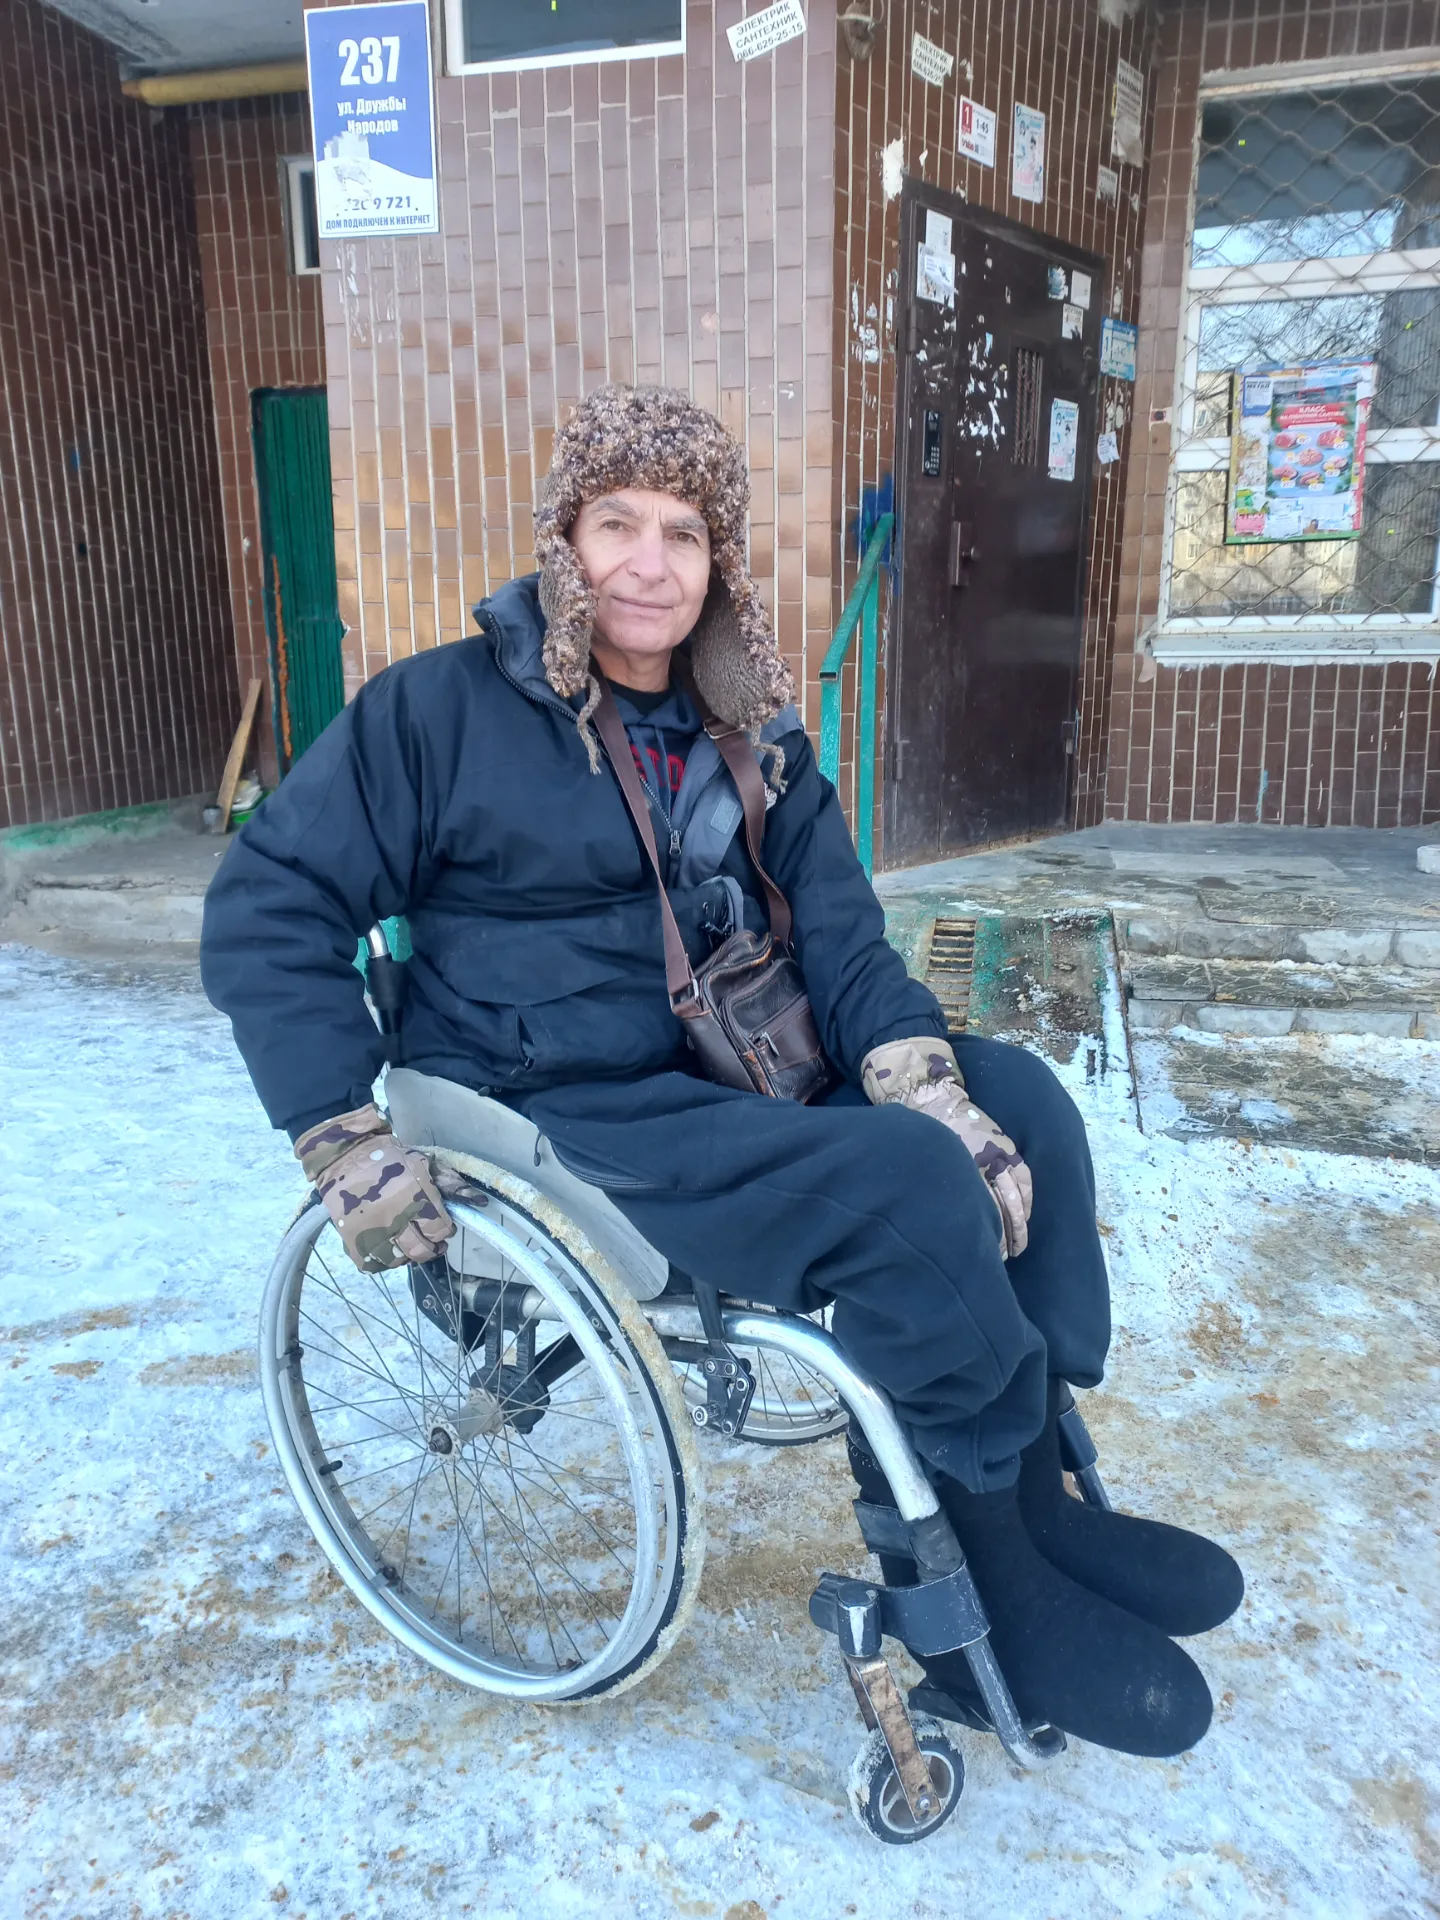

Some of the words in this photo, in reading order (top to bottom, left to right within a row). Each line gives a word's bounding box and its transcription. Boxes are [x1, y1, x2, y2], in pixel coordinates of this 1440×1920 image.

[736, 11, 798, 49] САНТЕХНИК
[737, 2, 791, 36] ЭЛЕКТРИК
[737, 21, 803, 60] 066-625-25-15
[338, 36, 400, 86] 237
[337, 102, 354, 116] ул.
[356, 96, 406, 116] Дружбы
[964, 105, 970, 125] 1
[347, 119, 398, 135] Народов
[326, 220, 342, 230] ДОМ
[343, 217, 389, 229] ПОДКЛЮЧЕН
[389, 217, 395, 225] К
[396, 214, 430, 225] ИНТЕРНЕТ
